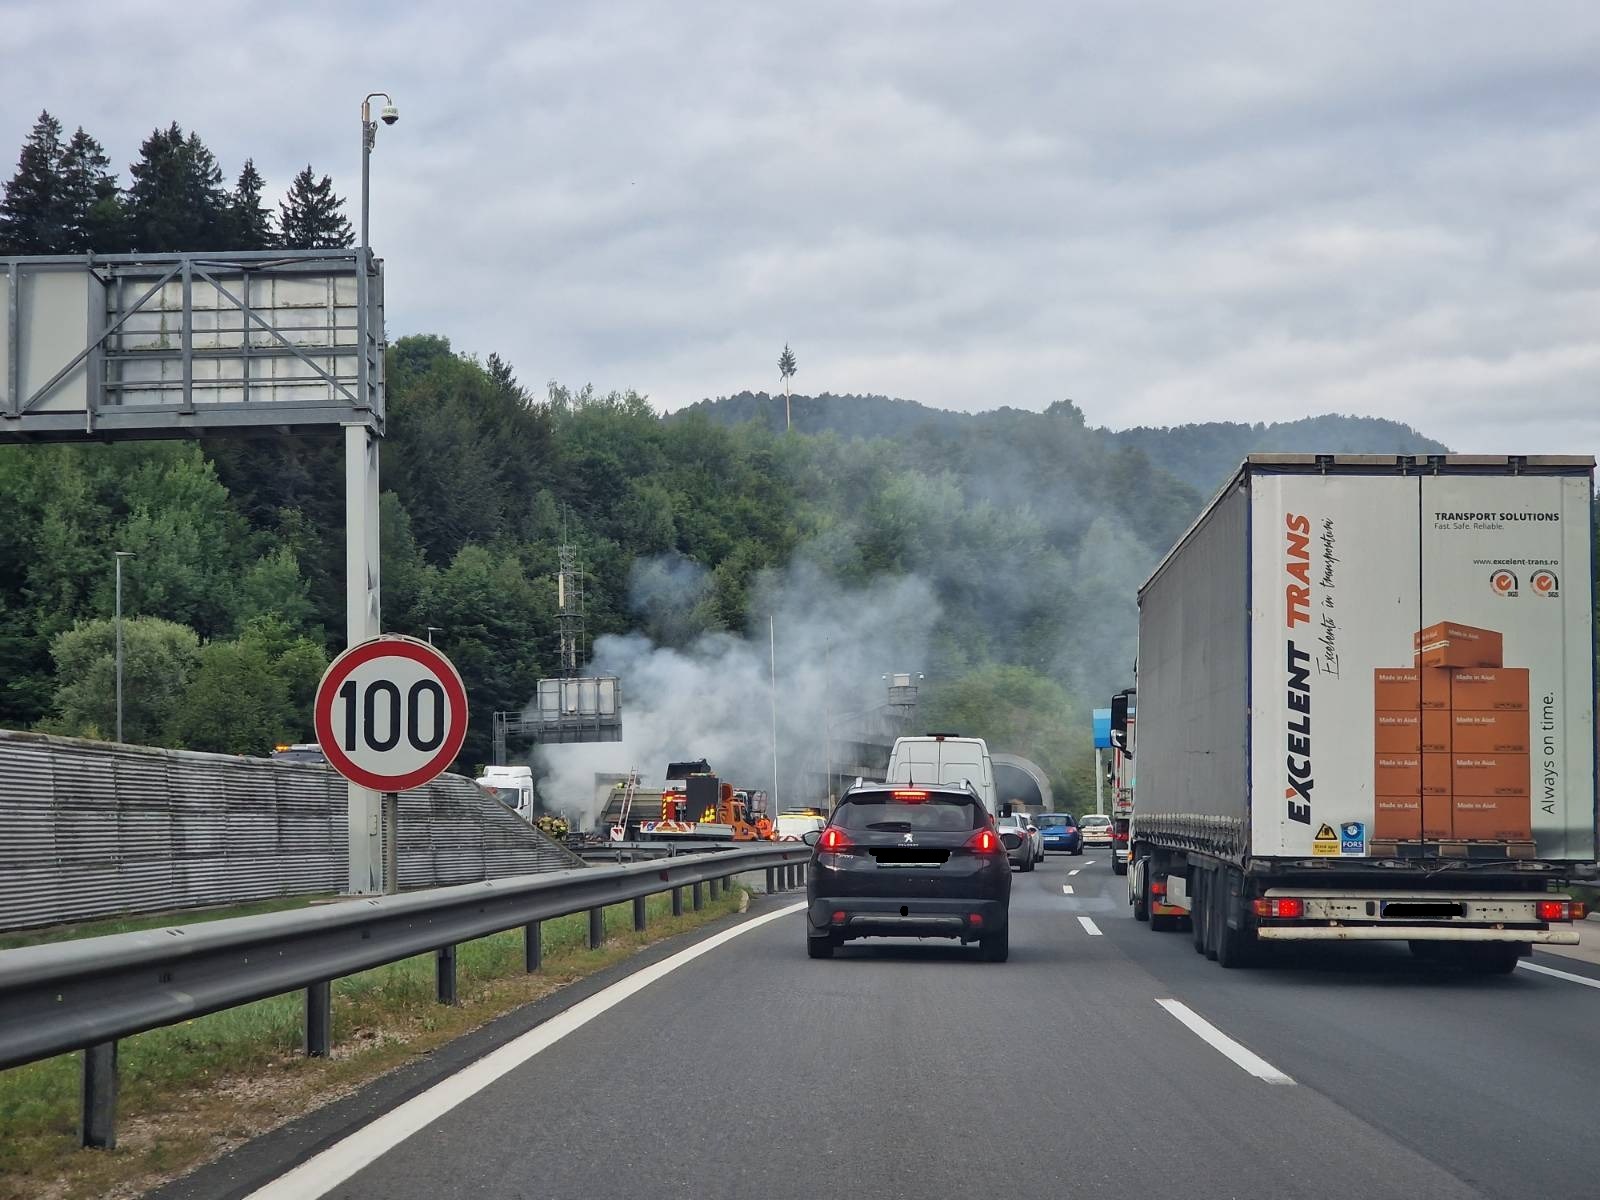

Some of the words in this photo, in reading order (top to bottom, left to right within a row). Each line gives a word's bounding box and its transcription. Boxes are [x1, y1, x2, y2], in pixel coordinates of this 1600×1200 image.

[1435, 512, 1496, 521] TRANSPORT
[1500, 512, 1560, 521] SOLUTIONS
[1473, 522, 1504, 530] Reliable.
[1286, 512, 1310, 628] TRANS
[1320, 518, 1340, 588] transporturi
[1473, 558, 1559, 566] www.excelent-trans.ro
[340, 679, 445, 752] 100
[1285, 639, 1314, 825] EXCELENT
[1540, 692, 1554, 731] time.
[1544, 736, 1554, 756] on
[1540, 760, 1558, 814] Always
